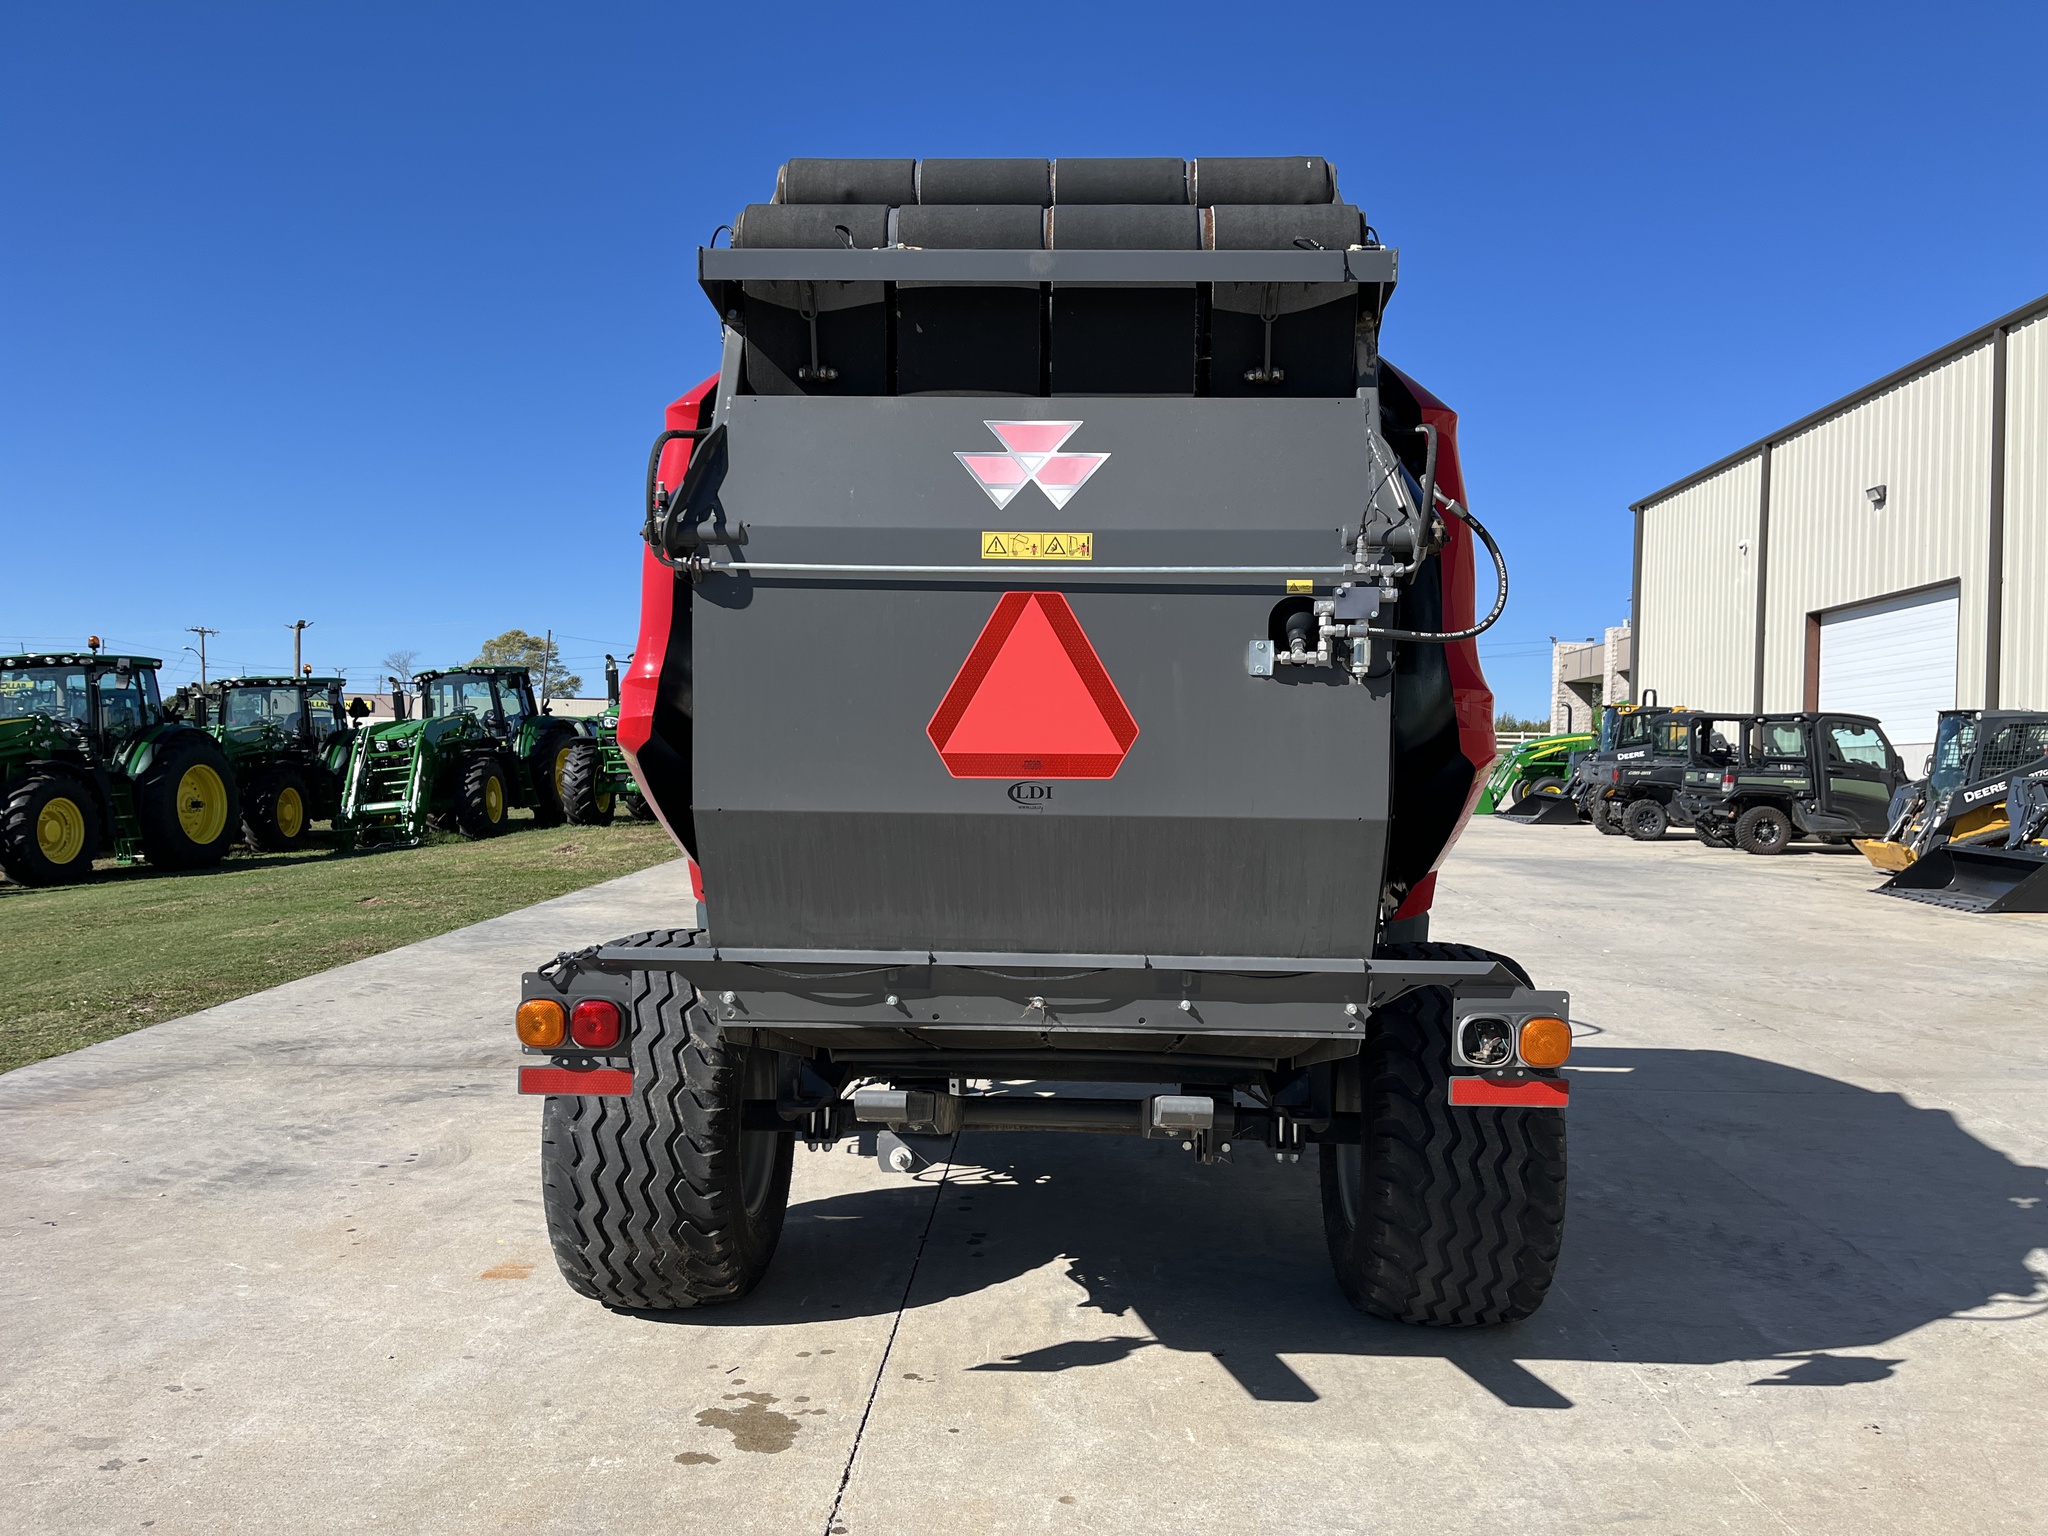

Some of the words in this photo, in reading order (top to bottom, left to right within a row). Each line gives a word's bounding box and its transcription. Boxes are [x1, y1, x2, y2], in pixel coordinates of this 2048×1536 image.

[1617, 750, 1645, 761] DEERE
[1015, 785, 1054, 799] LDI
[1963, 780, 2008, 803] DEERE
